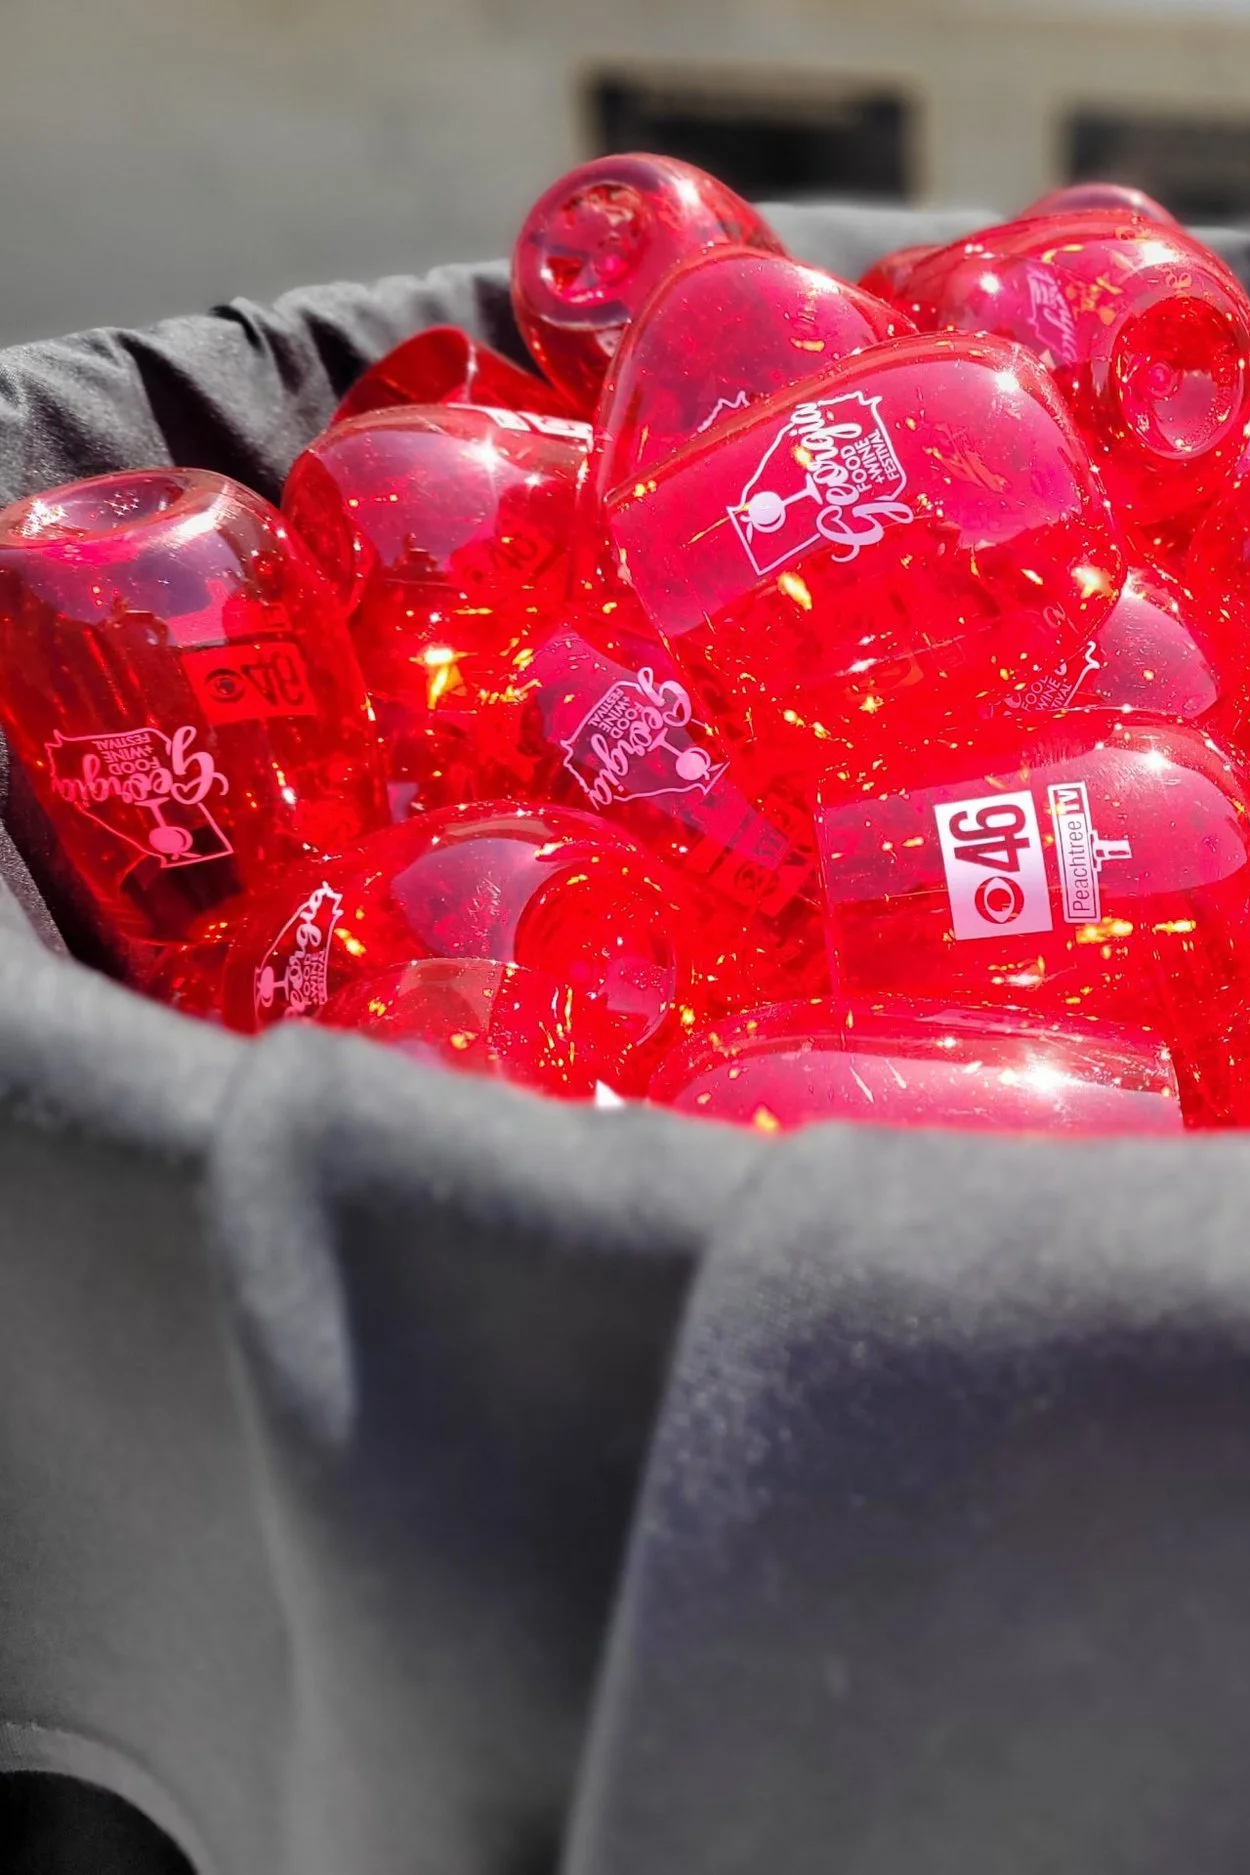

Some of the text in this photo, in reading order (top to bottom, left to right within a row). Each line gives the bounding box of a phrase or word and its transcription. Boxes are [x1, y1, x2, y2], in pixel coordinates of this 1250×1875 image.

[841, 445, 873, 493] FOOD
[869, 429, 900, 481] FESTIVAL
[790, 402, 914, 563] Georgia
[588, 688, 624, 727] FESTIVAL
[610, 701, 644, 739] FOOD
[91, 733, 152, 750] FESTIVAL
[587, 667, 704, 811] Georgia
[52, 726, 229, 807] Georgia
[108, 756, 160, 775] FOOD
[950, 804, 1031, 872] 46
[1055, 789, 1090, 912] Peachtree TV
